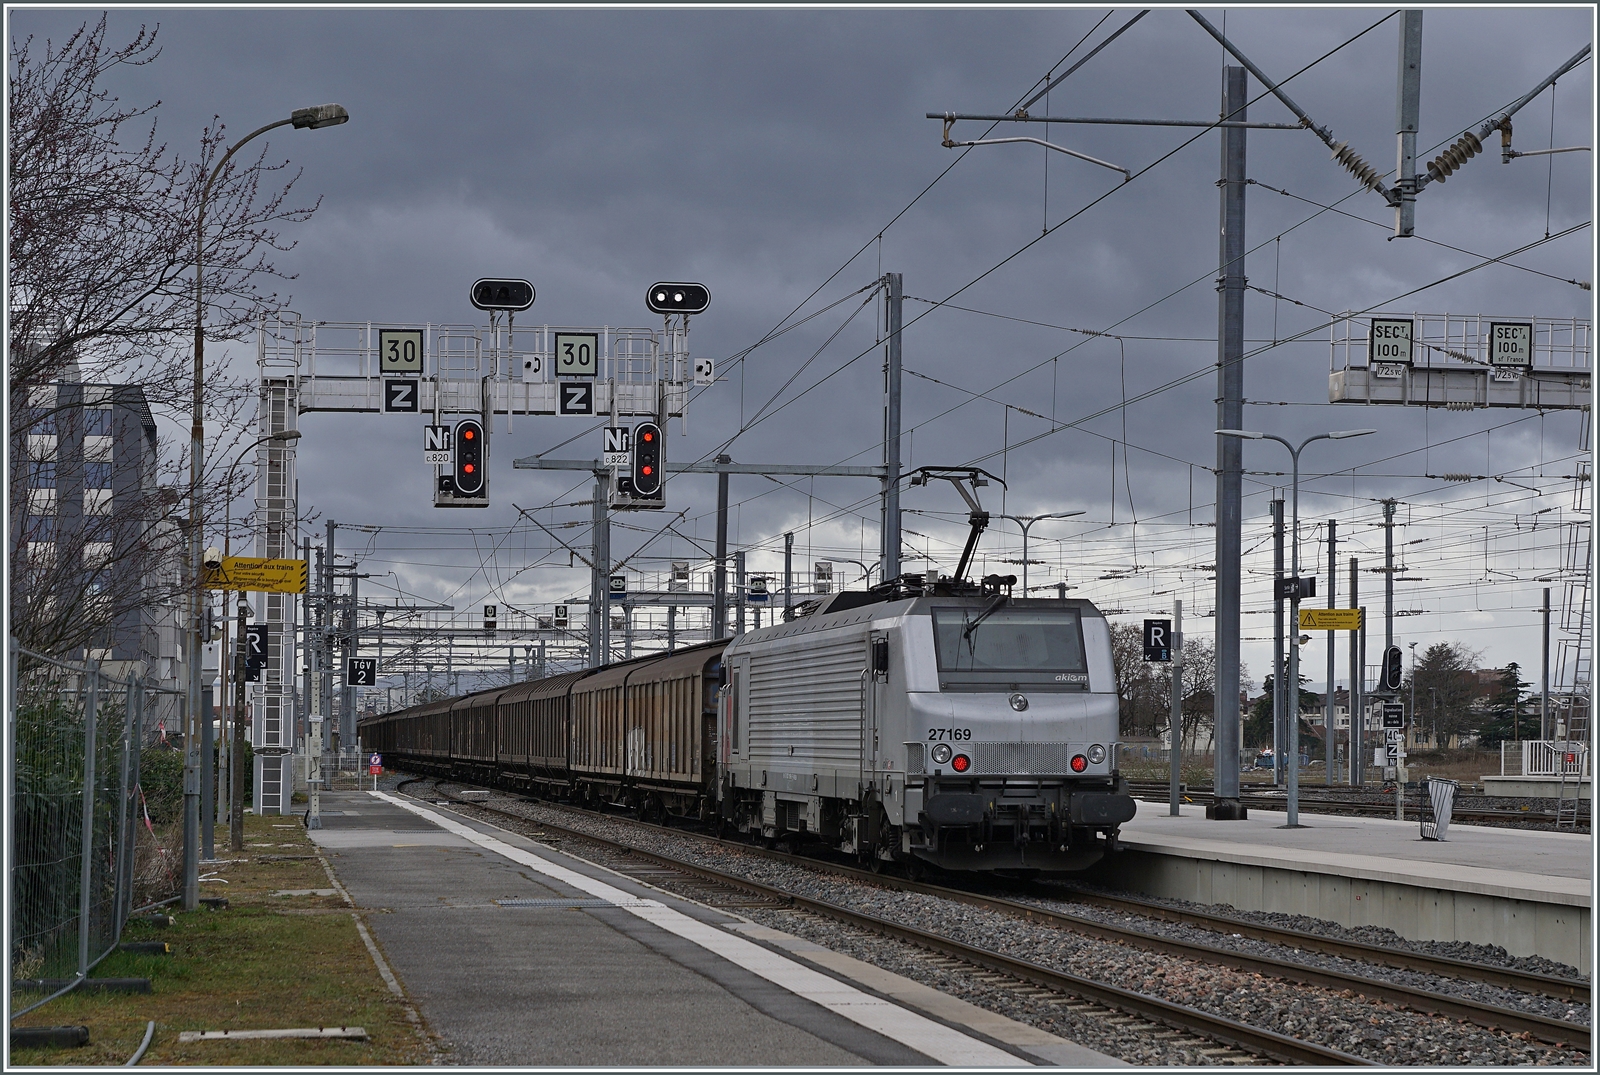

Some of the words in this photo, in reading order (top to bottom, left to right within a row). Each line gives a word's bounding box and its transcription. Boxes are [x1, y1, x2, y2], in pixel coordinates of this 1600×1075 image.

[387, 339, 416, 363] 30
[562, 342, 591, 366] 30
[391, 384, 412, 408] Z
[566, 387, 587, 410] Z
[425, 427, 450, 450] Nf
[604, 428, 629, 451] Nf
[234, 561, 263, 571] Attention
[246, 632, 261, 653] R
[1151, 626, 1165, 647] R
[353, 661, 372, 670] TGV
[357, 670, 367, 684] 2
[928, 728, 971, 741] 27169
[1388, 744, 1398, 756] Z
